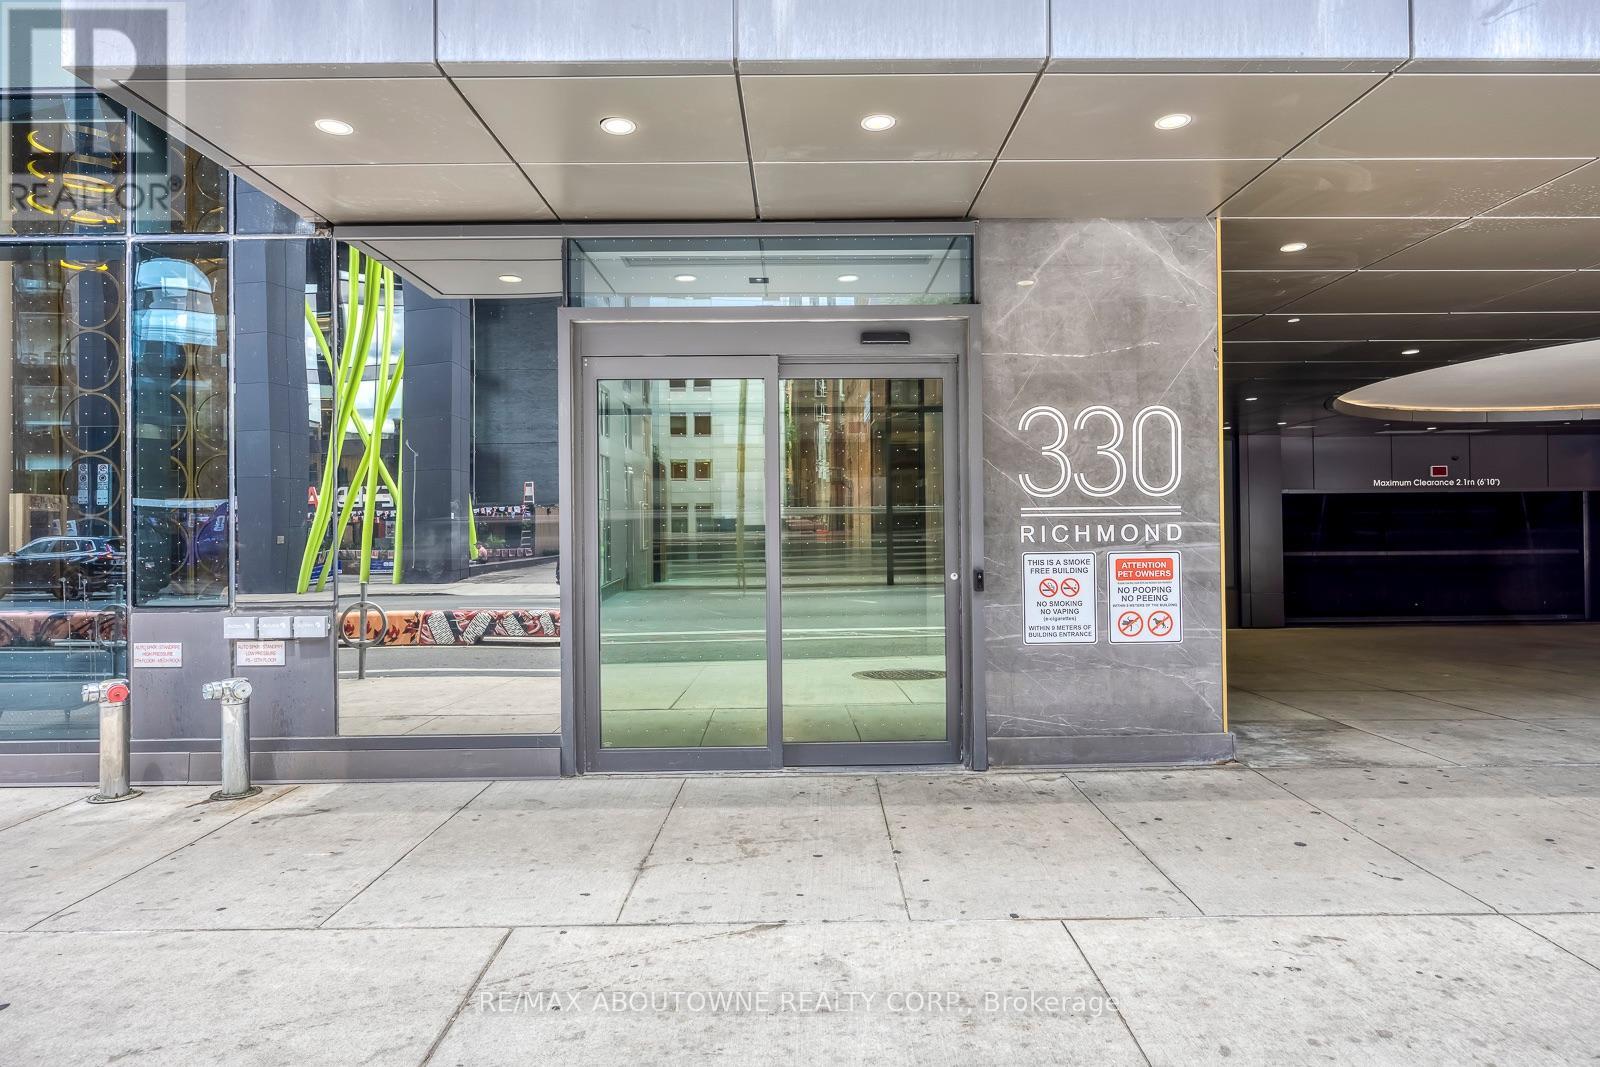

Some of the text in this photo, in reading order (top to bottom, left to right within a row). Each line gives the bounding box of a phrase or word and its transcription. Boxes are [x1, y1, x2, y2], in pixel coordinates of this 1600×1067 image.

[1018, 405, 1182, 498] 330
[1373, 479, 1412, 487] Maximum
[1413, 478, 1454, 486] Clearance
[1020, 523, 1182, 543] RICHMOND
[1063, 558, 1091, 566] SMOKE
[1121, 561, 1167, 569] ATTENTION
[1030, 567, 1050, 575] FREE
[1117, 570, 1133, 578] PET
[1132, 586, 1172, 594] POOPING
[1136, 594, 1169, 602] PEEING
